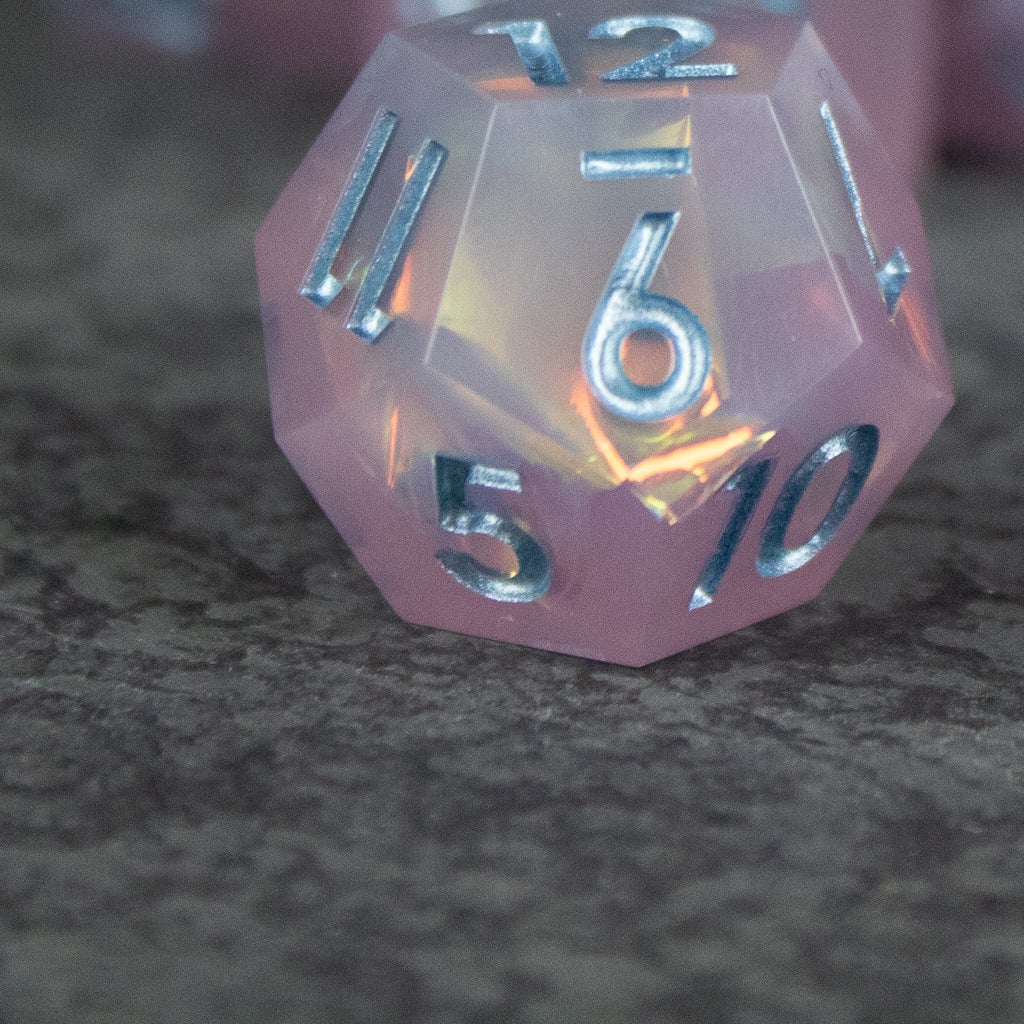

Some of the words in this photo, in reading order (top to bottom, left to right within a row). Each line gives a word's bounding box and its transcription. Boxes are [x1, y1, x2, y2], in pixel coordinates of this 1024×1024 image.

[469, 15, 739, 88] 12
[298, 105, 448, 344] 11
[433, 453, 552, 603] 5
[688, 425, 880, 610] 10
